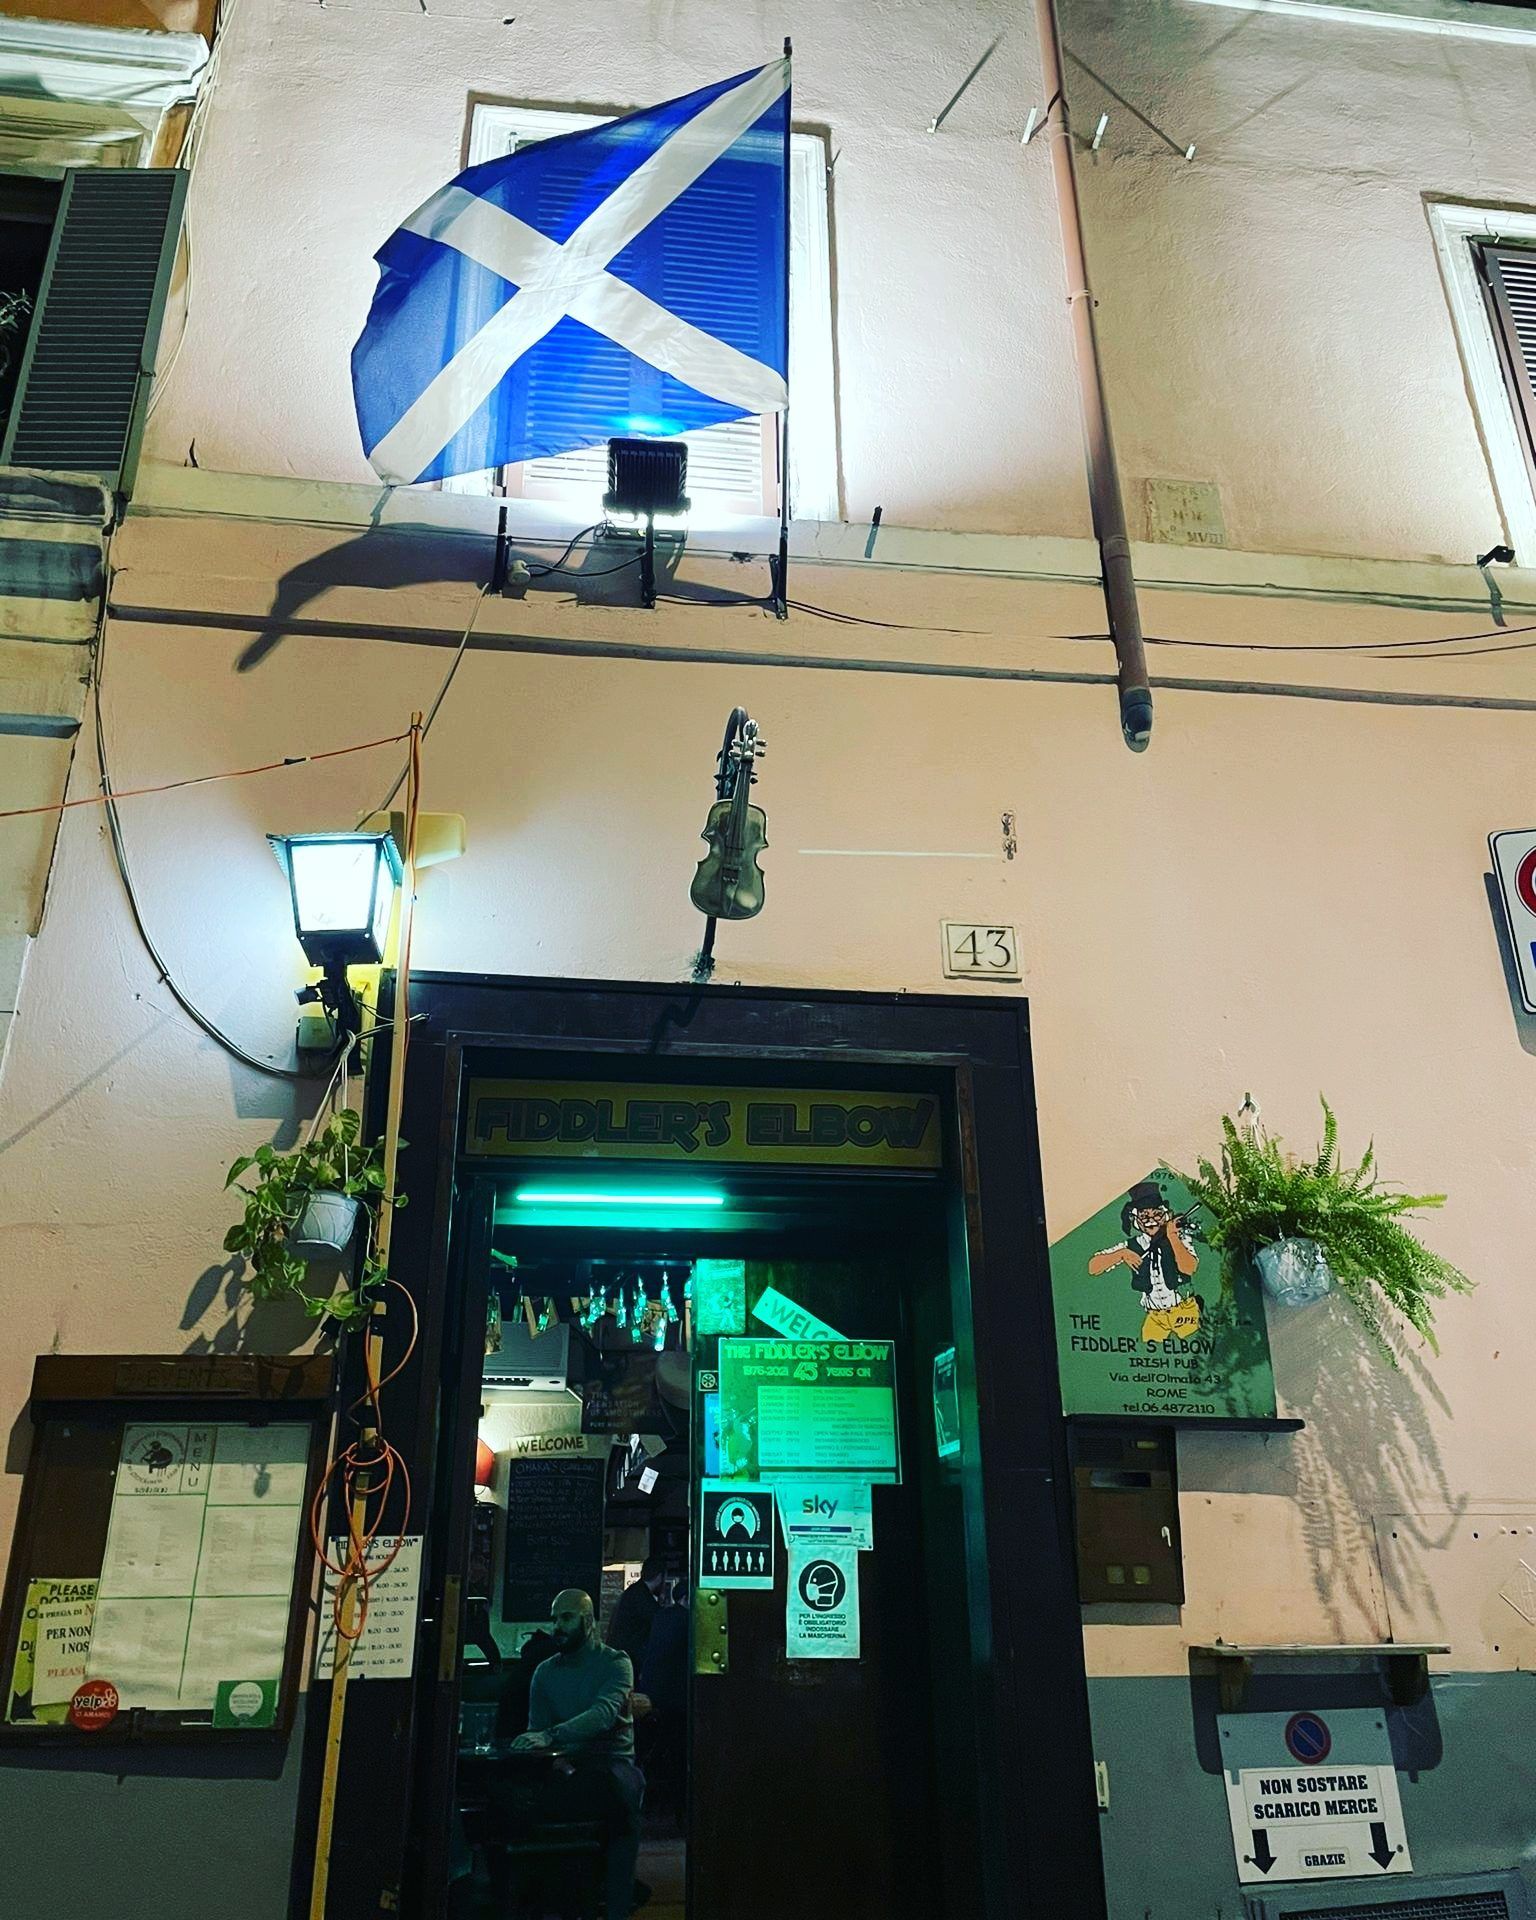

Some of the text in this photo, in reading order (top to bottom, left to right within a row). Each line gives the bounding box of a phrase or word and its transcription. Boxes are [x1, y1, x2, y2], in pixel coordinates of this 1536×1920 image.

[954, 929, 1011, 968] 43
[474, 1098, 935, 1153] FIDDLER'S ELBOW
[771, 1299, 838, 1340] WELC
[1070, 1314, 1101, 1331] THE
[725, 1343, 889, 1361] THE FIDDLER'S ELBOW
[1163, 1338, 1216, 1357] ELBOW
[793, 1361, 818, 1381] 45
[827, 1367, 854, 1377] YEARS
[857, 1368, 871, 1377] ON
[1129, 1357, 1199, 1370] IRISH PUB
[1109, 1372, 1129, 1383] Via
[1204, 1374, 1221, 1384] 43
[1146, 1388, 1188, 1399] ROME
[516, 1436, 584, 1453] WELCOME
[802, 1495, 838, 1519] sky
[49, 1584, 96, 1596] PLEASE
[46, 1626, 92, 1641] PER NON
[68, 1641, 90, 1654] NOS
[75, 1695, 102, 1709] yelp
[1260, 1775, 1368, 1795] NON SOSTARE
[1254, 1798, 1378, 1820] SCARICO MERCE
[1305, 1853, 1346, 1867] GRAZIE
